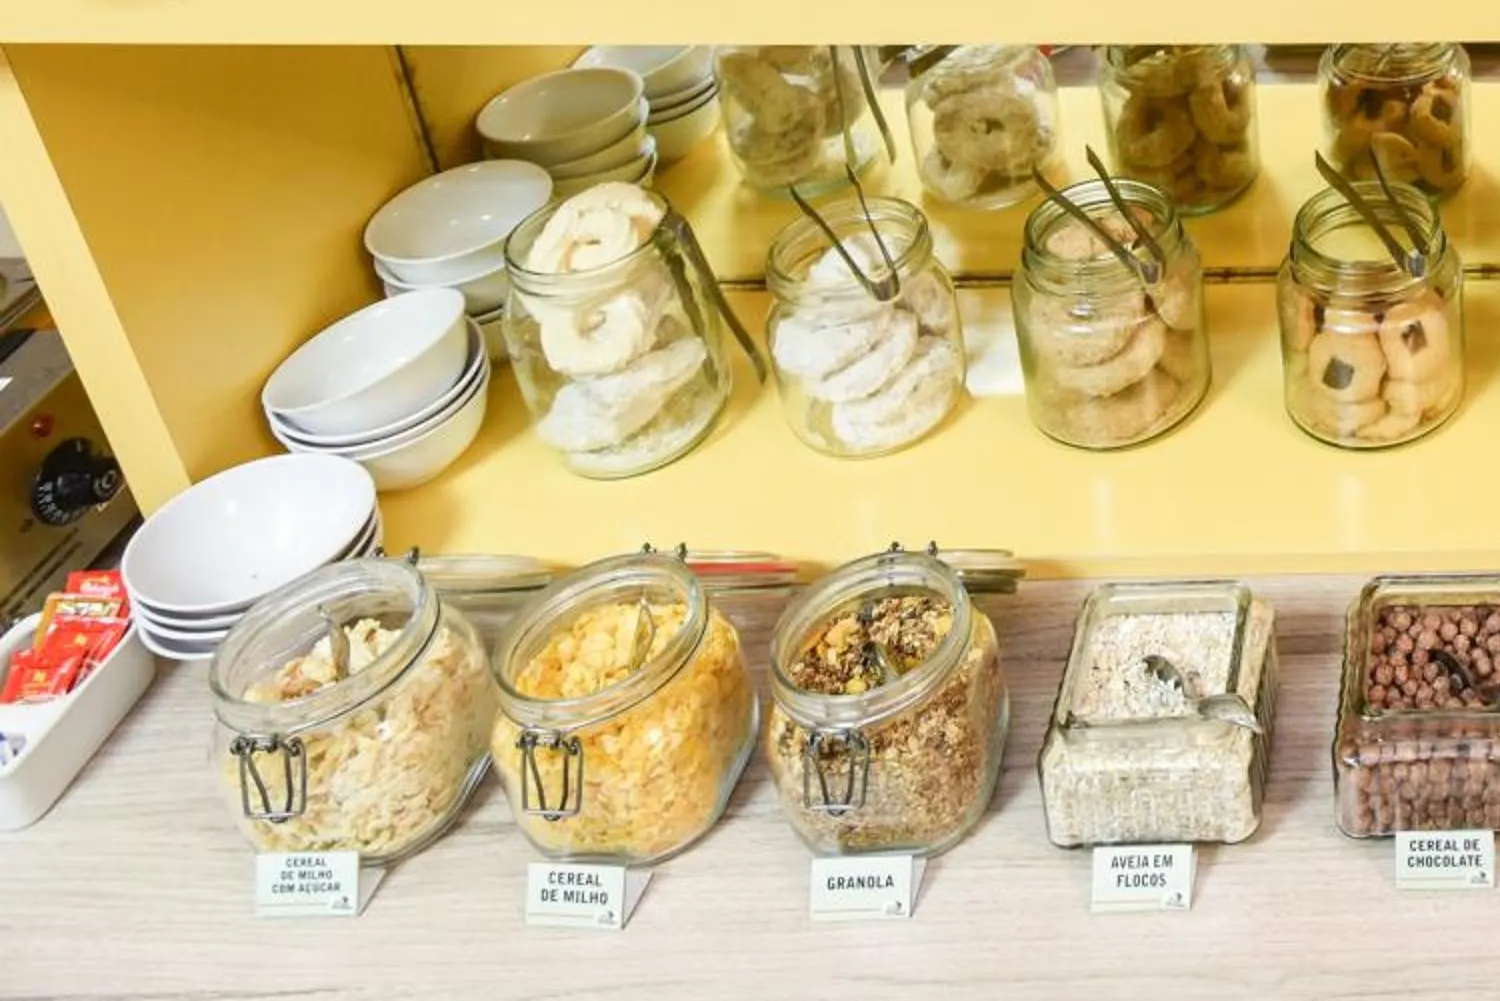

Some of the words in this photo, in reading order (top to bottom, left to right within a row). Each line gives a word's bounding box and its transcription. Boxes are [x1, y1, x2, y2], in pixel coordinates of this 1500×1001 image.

[1409, 839, 1460, 852] CEREAL
[1463, 838, 1481, 852] DE
[286, 857, 327, 868] CEREAL
[1111, 854, 1149, 869] AVEIA
[1153, 854, 1173, 868] EM
[1407, 854, 1483, 868] CHOCOLATE
[280, 870, 295, 881] DE
[297, 870, 333, 880] MILHO
[548, 871, 603, 887] CEREAL
[827, 874, 894, 891] GRANOLA
[1116, 873, 1167, 888] FLOCOS
[271, 883, 295, 894] COM
[541, 888, 558, 902] DE
[563, 890, 609, 905] MILHO
